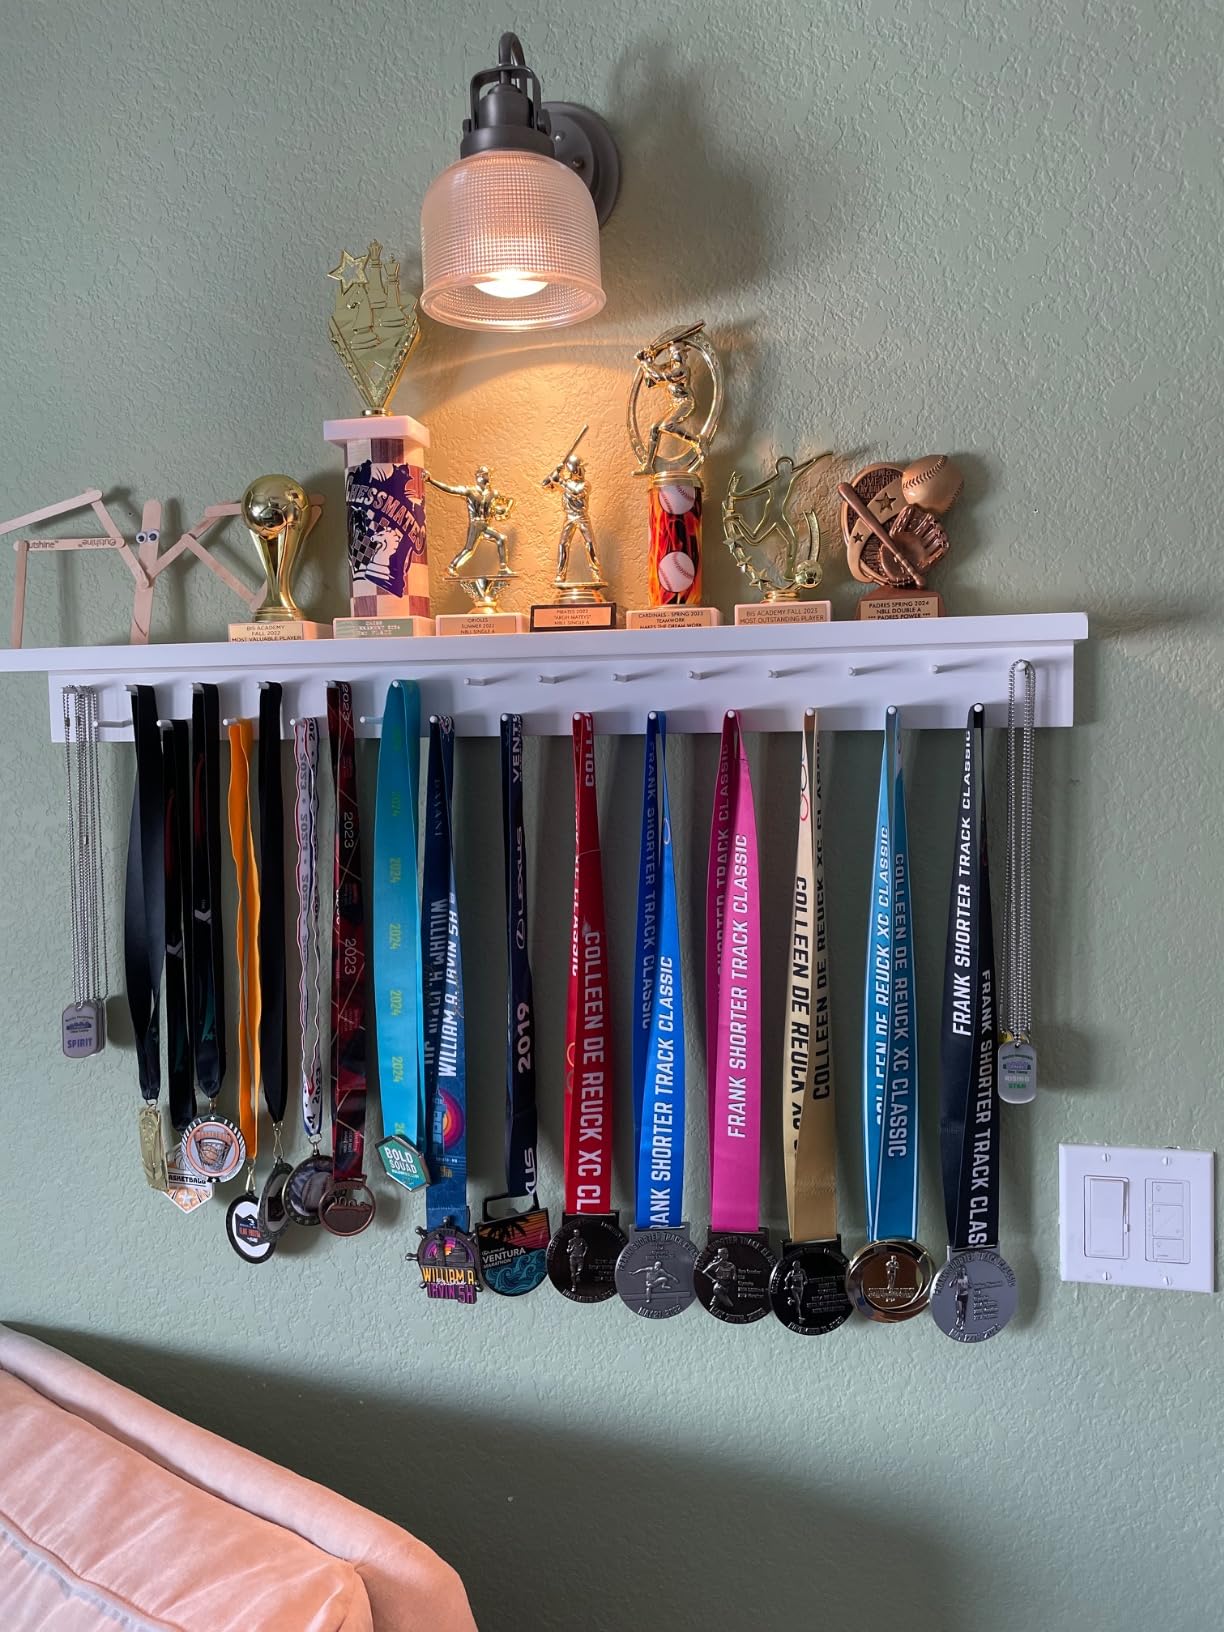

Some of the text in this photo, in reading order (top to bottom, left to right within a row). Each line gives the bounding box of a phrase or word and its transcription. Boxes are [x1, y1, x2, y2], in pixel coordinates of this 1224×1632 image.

[30, 540, 56, 549] utshine
[757, 615, 800, 624] OUTSTANDING
[344, 812, 354, 848] 2023
[645, 808, 656, 886] SHORTER
[716, 829, 729, 888] TRACK
[879, 826, 889, 907] CLASSIC
[952, 729, 972, 1036] FRANK SHORTER TRACK CLASSIC
[389, 923, 402, 950] 2024
[643, 891, 656, 949] TRACK
[793, 876, 809, 979] COLLEEN
[816, 879, 826, 952] REUCK
[877, 913, 889, 937] XC
[344, 938, 356, 975] 2023
[446, 940, 457, 985] IRVIN
[584, 931, 604, 1029] COLLEEN
[817, 958, 827, 989] DE
[875, 944, 889, 1007] REUCK
[390, 989, 403, 1016] 2024
[444, 991, 458, 1006] A.
[642, 954, 655, 1029] CLASSIC
[658, 956, 674, 1032] CLASSIC
[727, 834, 748, 1138] FRANK SHORTER TRACK CLASSIC
[792, 985, 810, 1016] DE
[888, 853, 909, 1157] COLLEEN DE REUCK XC CLASSIC
[67, 1038, 92, 1049] SPIRIT
[438, 1009, 458, 1077] WILLIAM
[517, 1002, 531, 1074] 2019
[583, 1036, 604, 1064] DE
[655, 1037, 674, 1095] TRACK
[814, 996, 830, 1100] COLLEEN
[391, 1056, 404, 1082] 2024
[579, 1071, 604, 1142] REUCK
[967, 970, 993, 1244] FRANK SHORTER TRACK CLAS
[384, 1146, 413, 1163] BOLD
[389, 1159, 417, 1174] SQUAD
[578, 1149, 602, 1177] XC
[650, 1102, 673, 1181] SHORTER
[422, 1267, 464, 1285] WILLIAM
[482, 1247, 526, 1264] VENTURA
